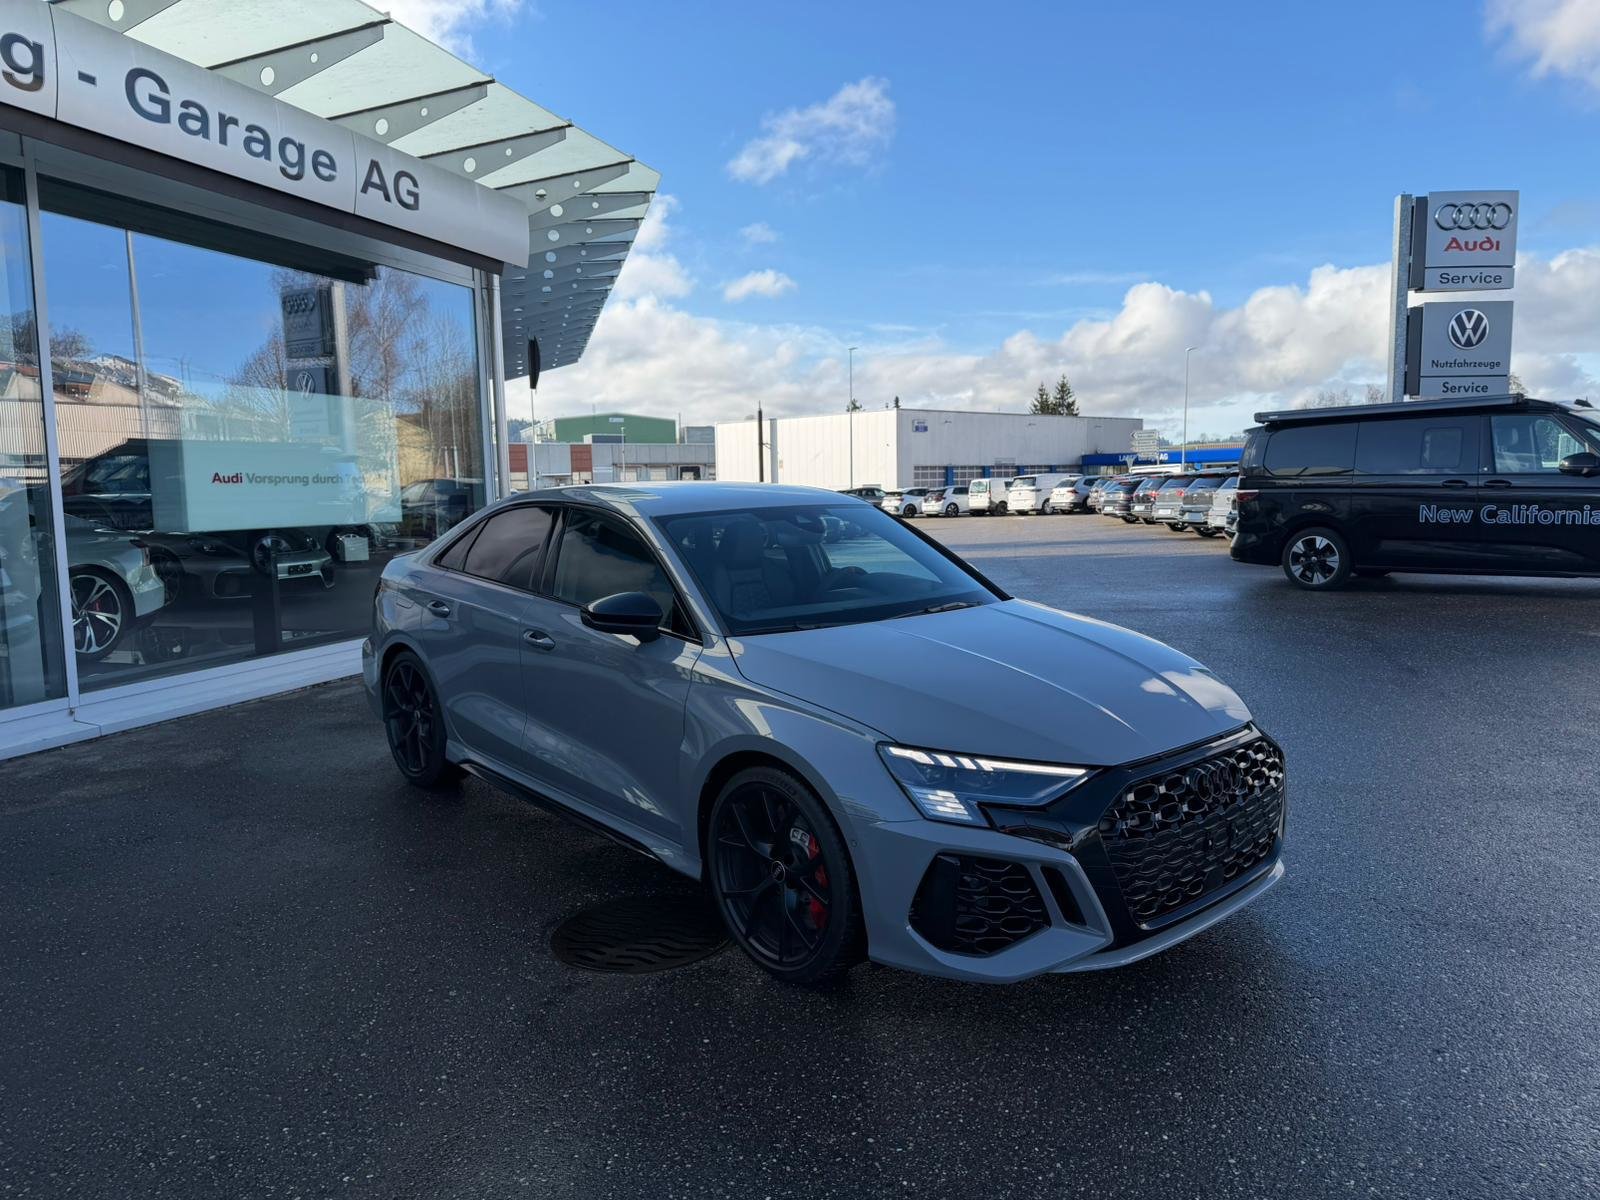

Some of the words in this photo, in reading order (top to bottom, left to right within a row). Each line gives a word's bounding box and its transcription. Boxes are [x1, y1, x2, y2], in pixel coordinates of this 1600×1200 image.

[125, 66, 338, 183] Garage
[360, 159, 420, 211] AG
[1444, 237, 1500, 251] Audi
[1439, 272, 1503, 285] Service
[1431, 359, 1501, 370] Nutzfahrzeuge
[1442, 382, 1489, 394] Service
[212, 472, 243, 484] Audi
[246, 473, 310, 486] Vorsprung
[312, 473, 344, 484] durch
[1419, 504, 1474, 523] New
[1480, 504, 1600, 525] California
